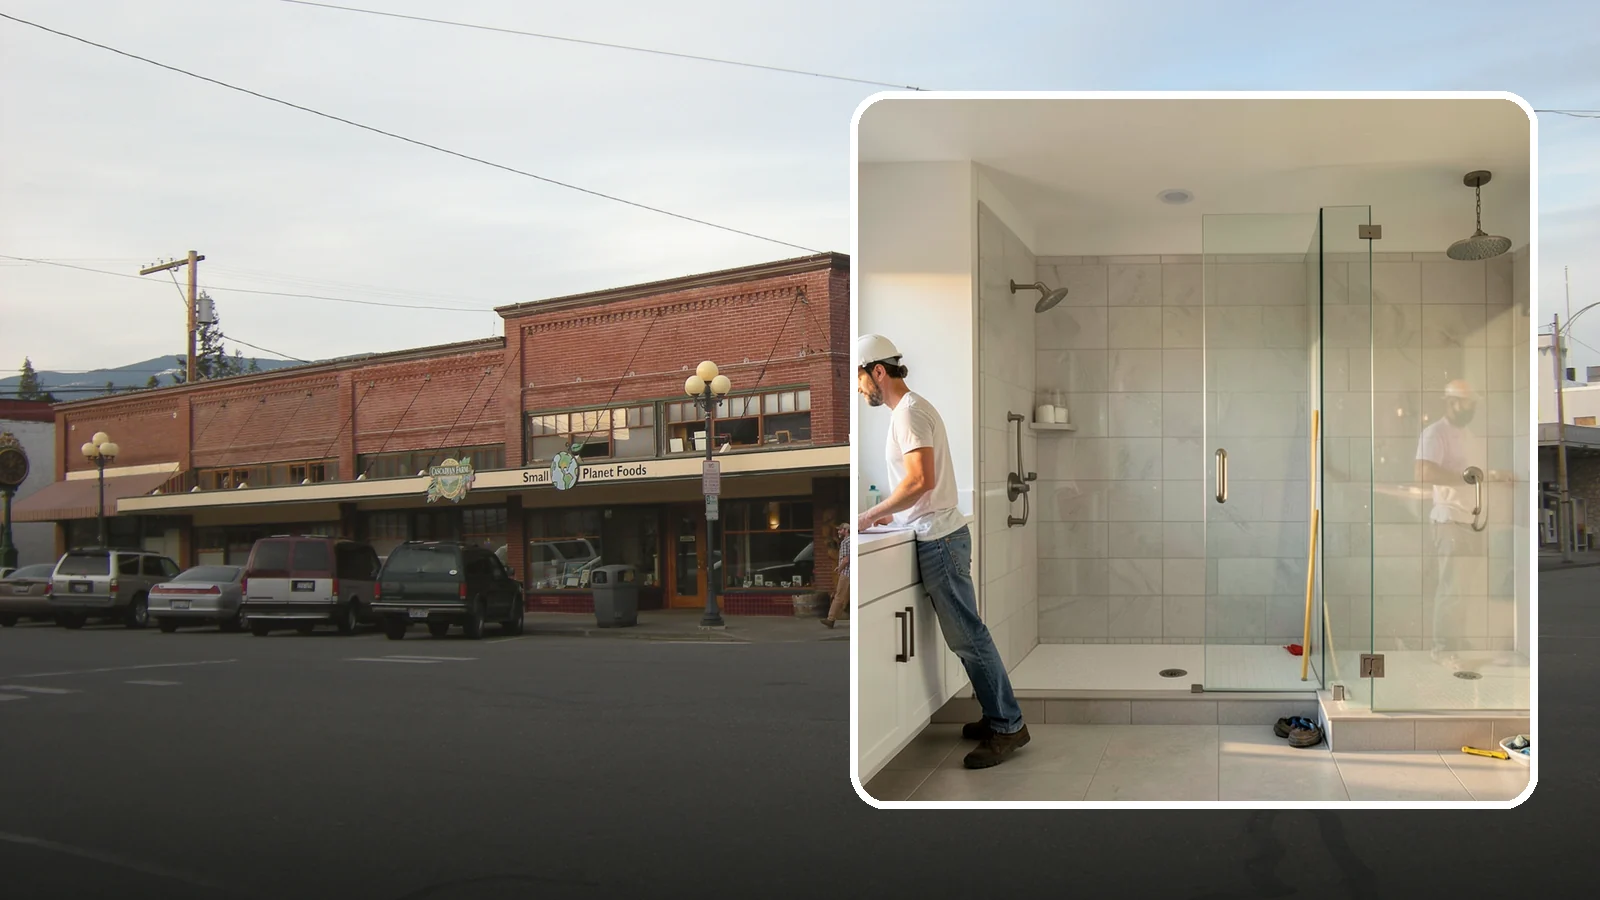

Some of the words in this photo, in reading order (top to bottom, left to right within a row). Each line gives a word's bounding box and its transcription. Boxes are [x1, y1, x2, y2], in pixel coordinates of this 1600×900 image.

[523, 471, 549, 483] Small
[583, 467, 614, 479] Planet
[617, 464, 647, 476] Foods
